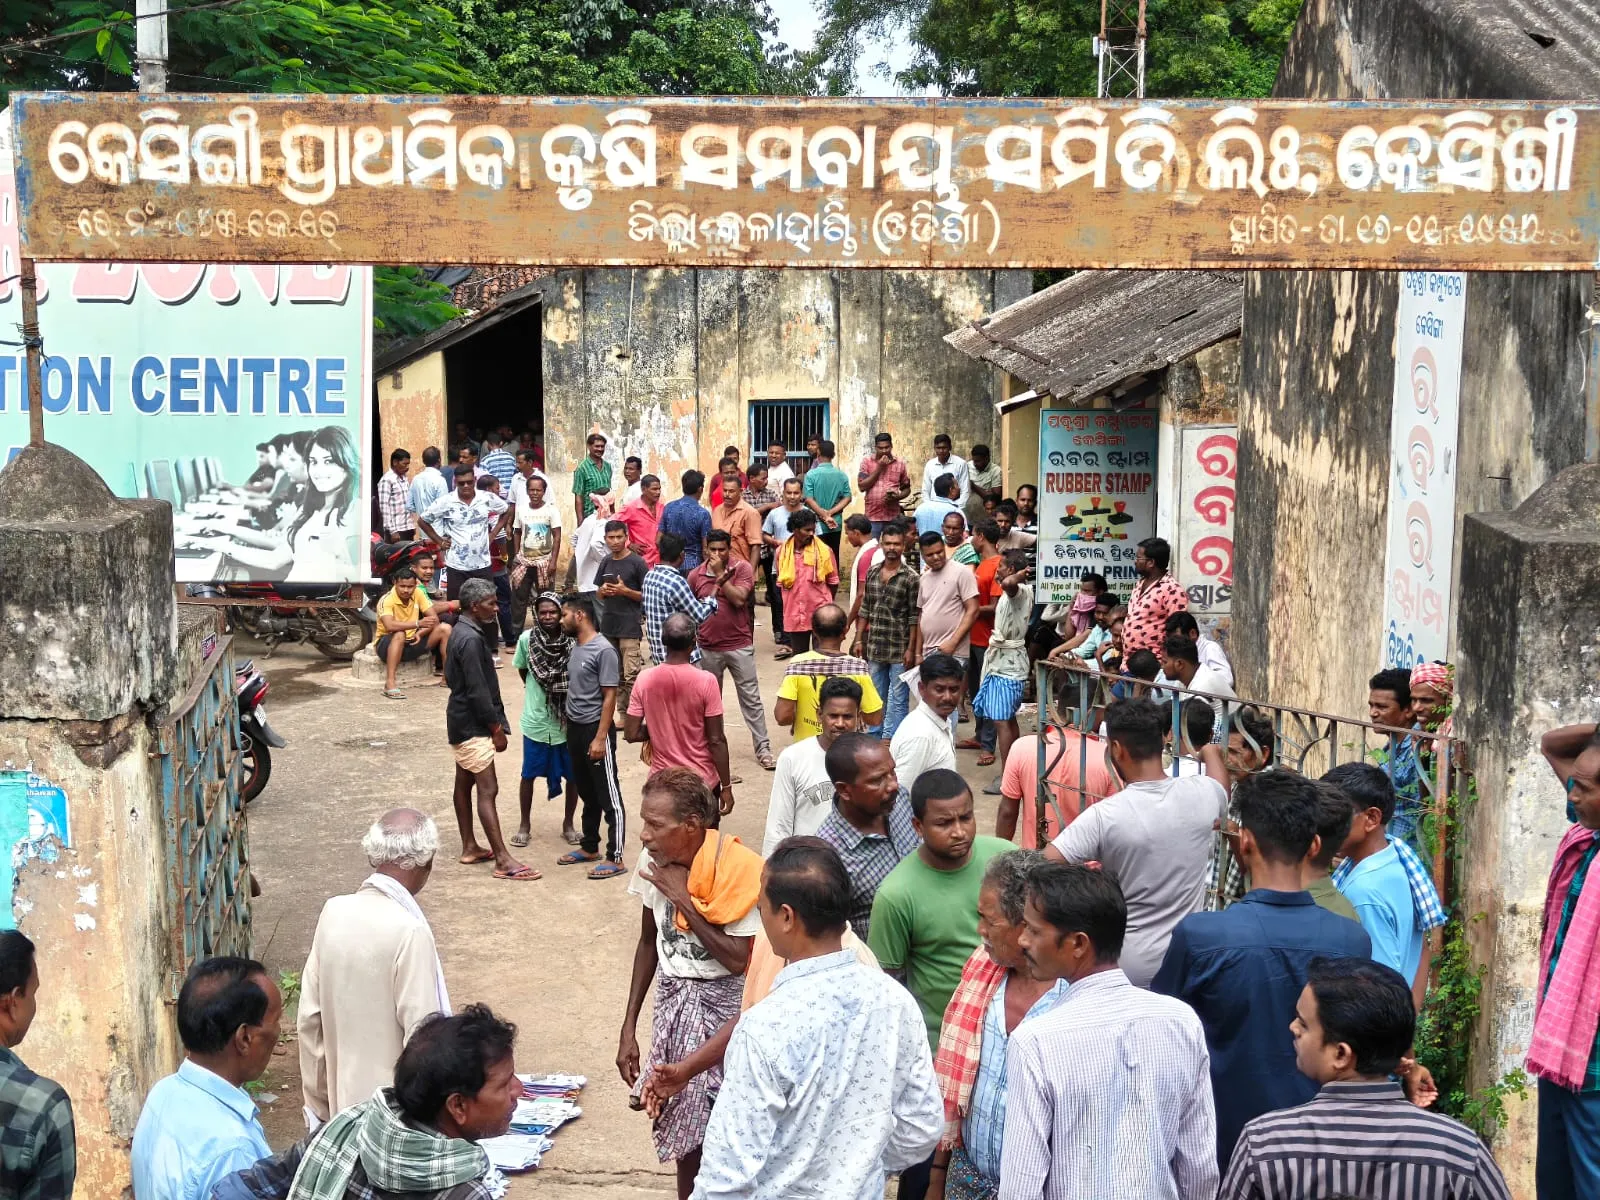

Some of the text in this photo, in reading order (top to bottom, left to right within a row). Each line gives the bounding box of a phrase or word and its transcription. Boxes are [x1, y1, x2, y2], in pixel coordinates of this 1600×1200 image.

[278, 106, 515, 206] ପ୍ରାଥମିକ
[539, 107, 658, 210] କୃଷି
[131, 355, 346, 415] CENTRE
[1048, 450, 1100, 467] ରବର
[1045, 472, 1153, 494] RUBBER STAMP
[1041, 582, 1049, 591] All
[1050, 582, 1064, 592] Type
[1064, 582, 1072, 590] of
